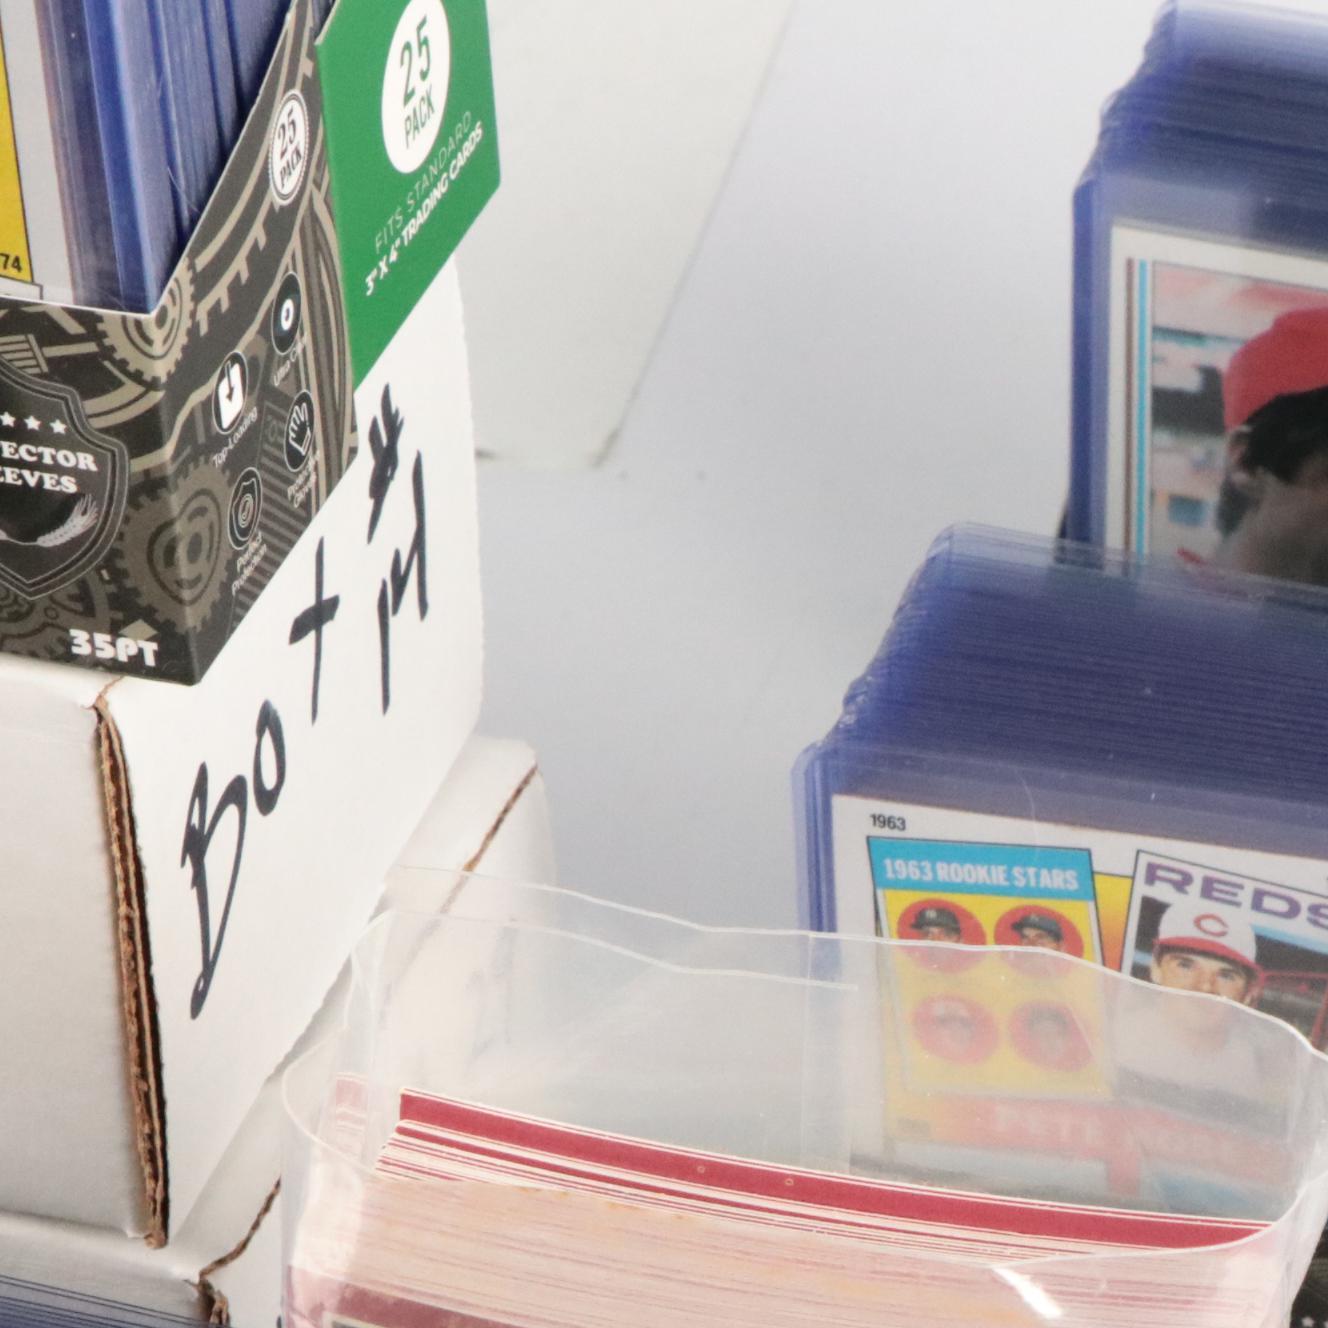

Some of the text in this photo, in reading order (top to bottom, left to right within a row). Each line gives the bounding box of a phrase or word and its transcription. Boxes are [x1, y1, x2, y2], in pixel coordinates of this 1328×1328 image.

[400, 14, 431, 107] 25
[278, 107, 297, 160] 25
[404, 84, 435, 149] PACK
[280, 141, 303, 189] PACK
[375, 110, 472, 254] FITS STANDARD
[402, 172, 449, 246] TRADING
[449, 120, 483, 180] CARDS
[0, 252, 22, 273] 74
[0, 440, 98, 473] ECTOR
[69, 628, 158, 667] 35PT
[870, 813, 907, 831] 1963
[883, 857, 1079, 891] 1963 ROOKIE STARS
